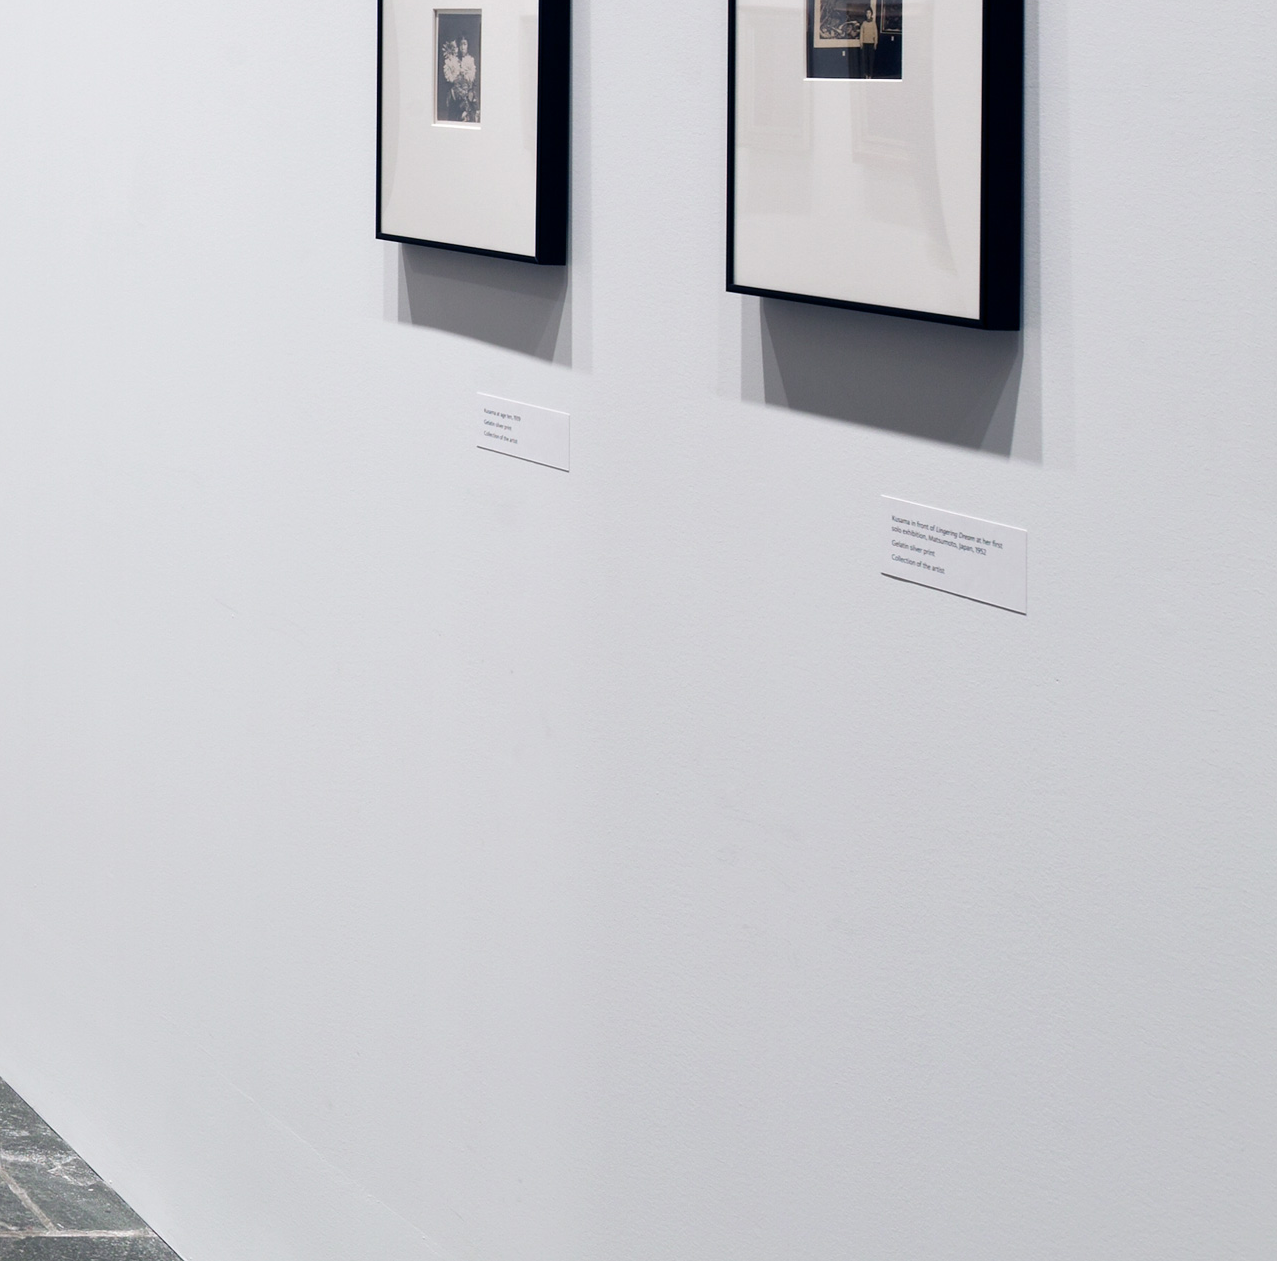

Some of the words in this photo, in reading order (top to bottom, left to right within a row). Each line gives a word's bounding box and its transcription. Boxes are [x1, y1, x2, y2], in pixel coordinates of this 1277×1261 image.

[891, 515, 910, 526] Kusama
[917, 521, 929, 531] front
[930, 523, 935, 531] of
[936, 526, 958, 539] Lingering
[983, 537, 991, 546] her
[992, 540, 1003, 549] first
[891, 526, 902, 534] solo
[903, 529, 928, 541] exhibition,
[892, 540, 909, 549] Gelatin
[891, 554, 916, 566] Collection
[923, 561, 931, 570] the
